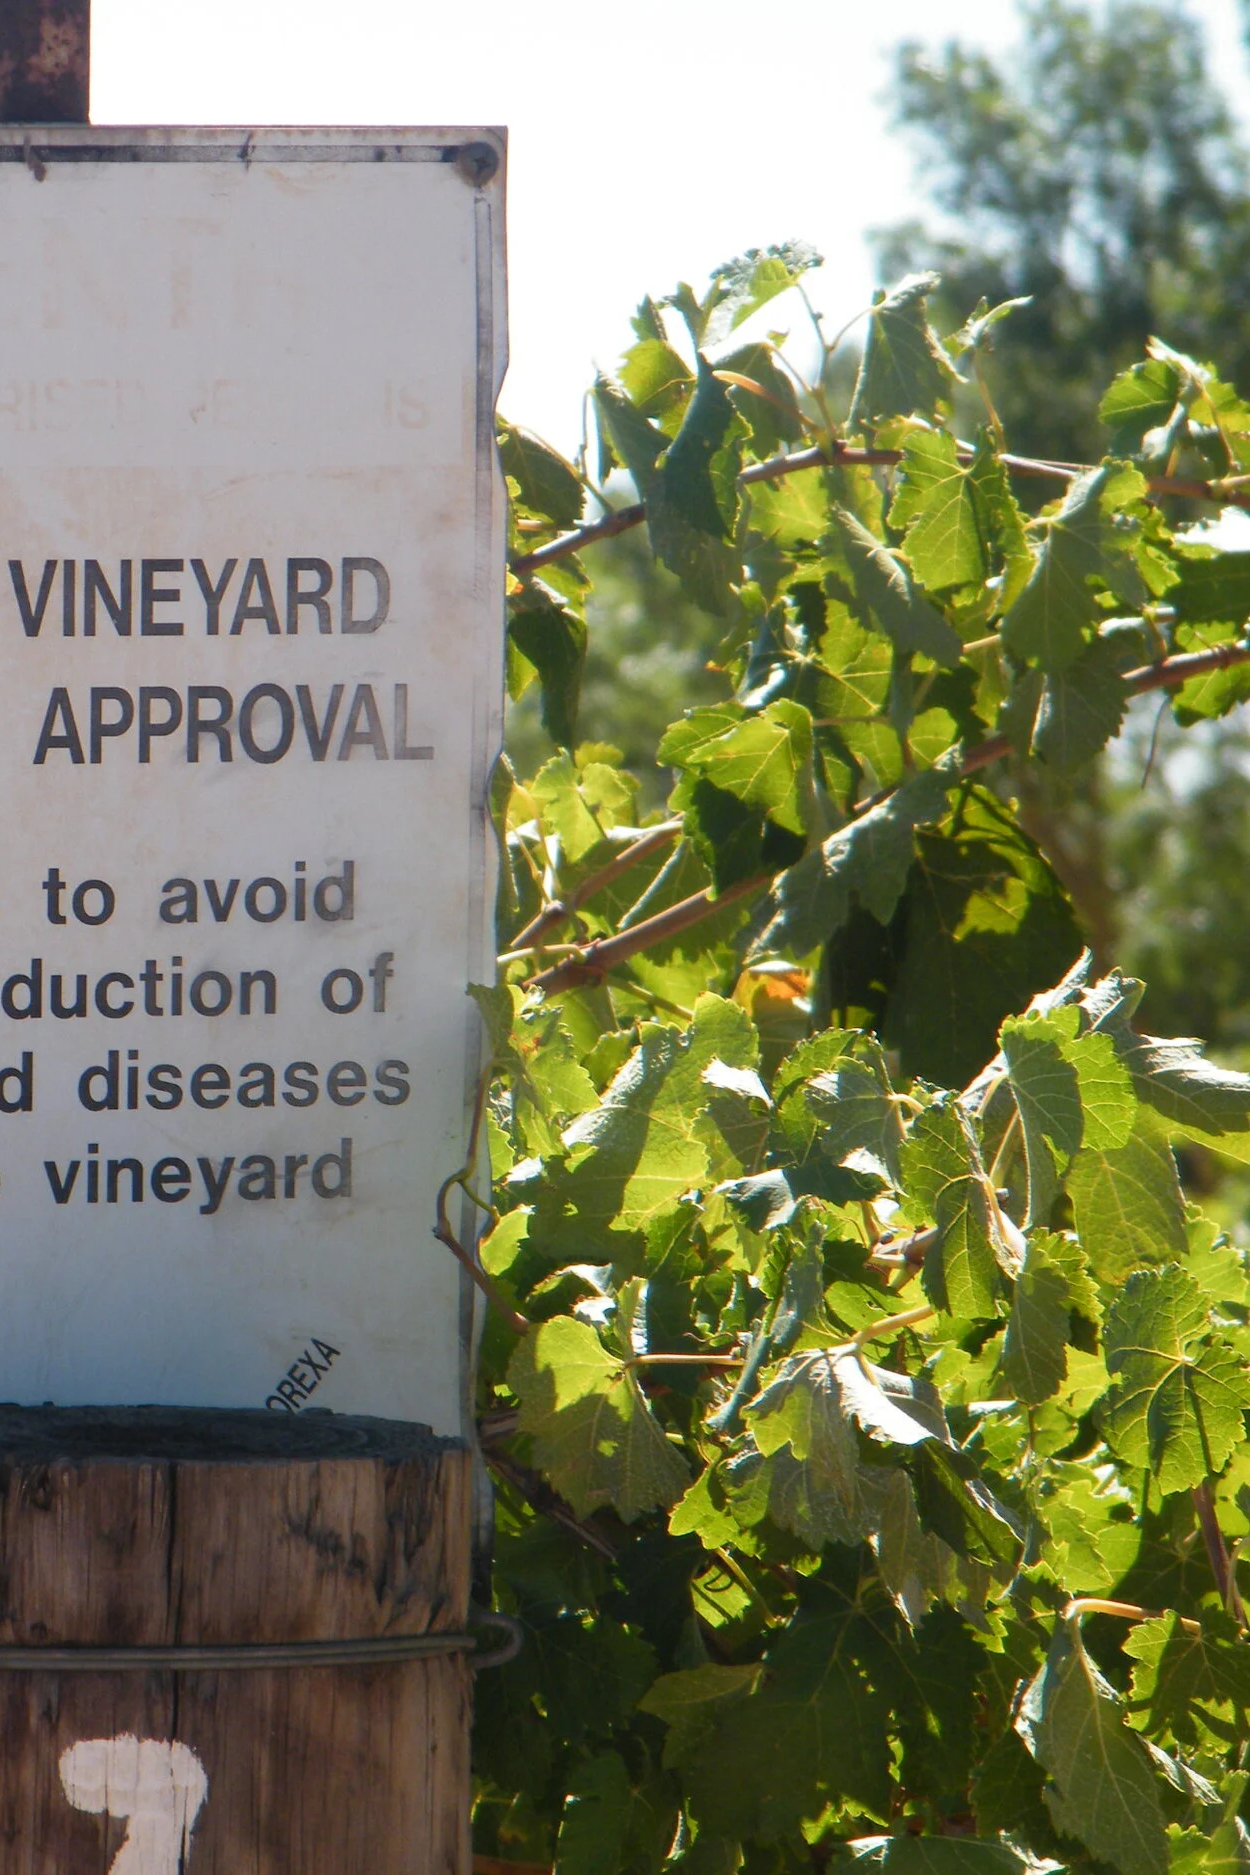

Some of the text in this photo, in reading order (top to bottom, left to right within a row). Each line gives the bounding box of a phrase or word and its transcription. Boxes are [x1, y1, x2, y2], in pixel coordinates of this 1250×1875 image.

[8, 557, 391, 638] VINEYARD
[33, 683, 434, 766] APPROVAL
[42, 868, 115, 926] to
[159, 860, 355, 924] avoid
[321, 952, 394, 1014] of
[78, 1049, 410, 1112] diseases
[44, 1138, 352, 1215] vineyard
